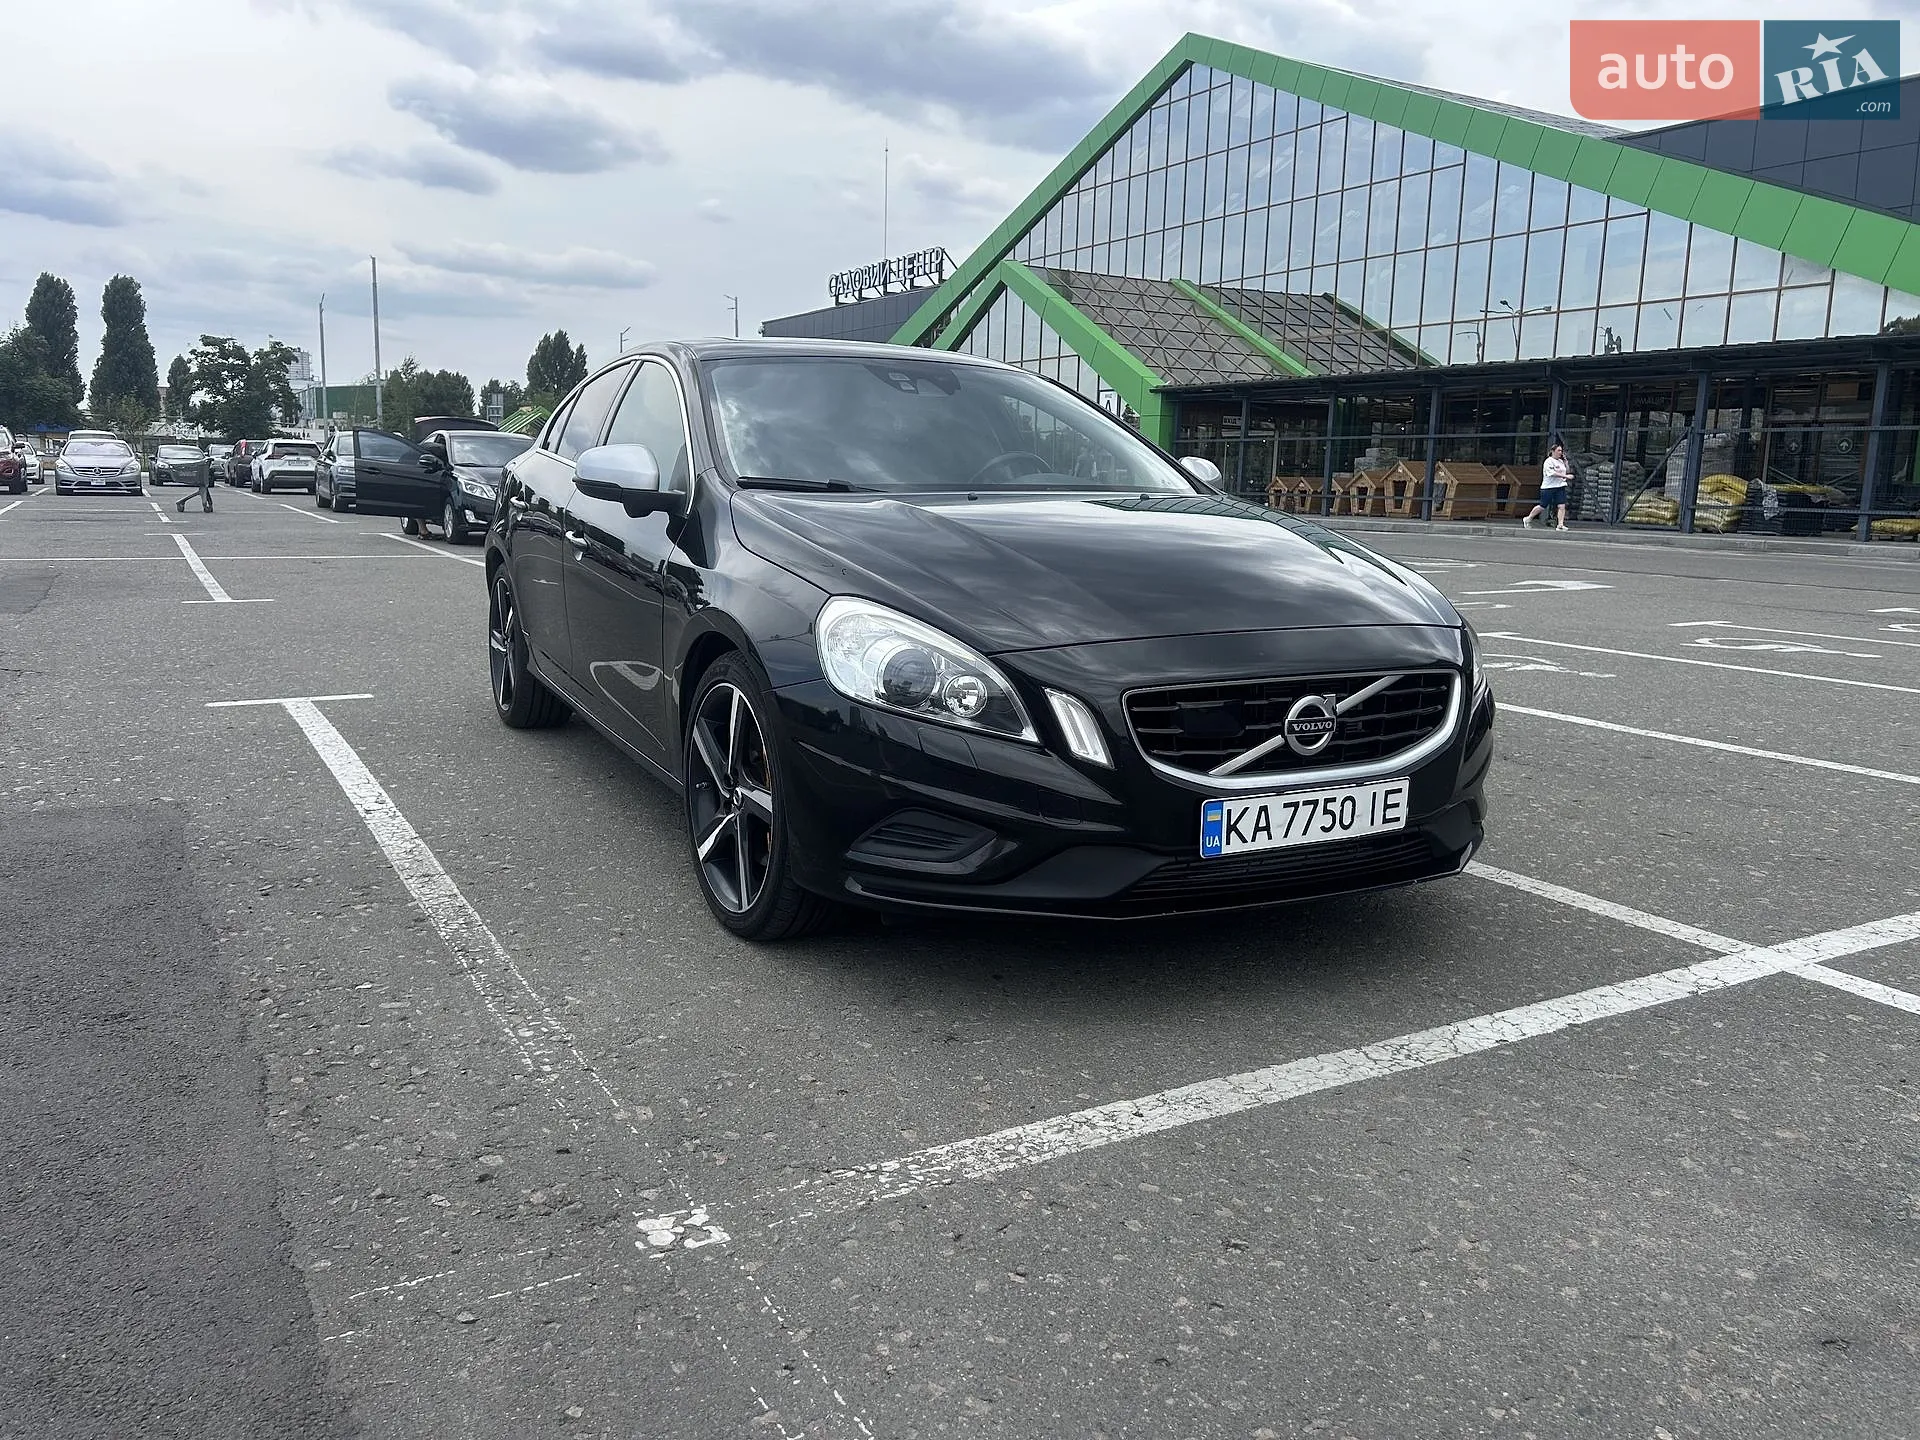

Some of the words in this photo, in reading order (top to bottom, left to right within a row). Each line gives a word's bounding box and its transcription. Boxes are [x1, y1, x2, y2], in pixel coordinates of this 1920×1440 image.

[895, 247, 944, 284] ЦЕНТР
[1291, 720, 1333, 731] VOLVO
[1205, 835, 1221, 848] UA
[1225, 804, 1273, 846] KA
[1282, 795, 1357, 839] 7750
[1369, 787, 1403, 827] IE
